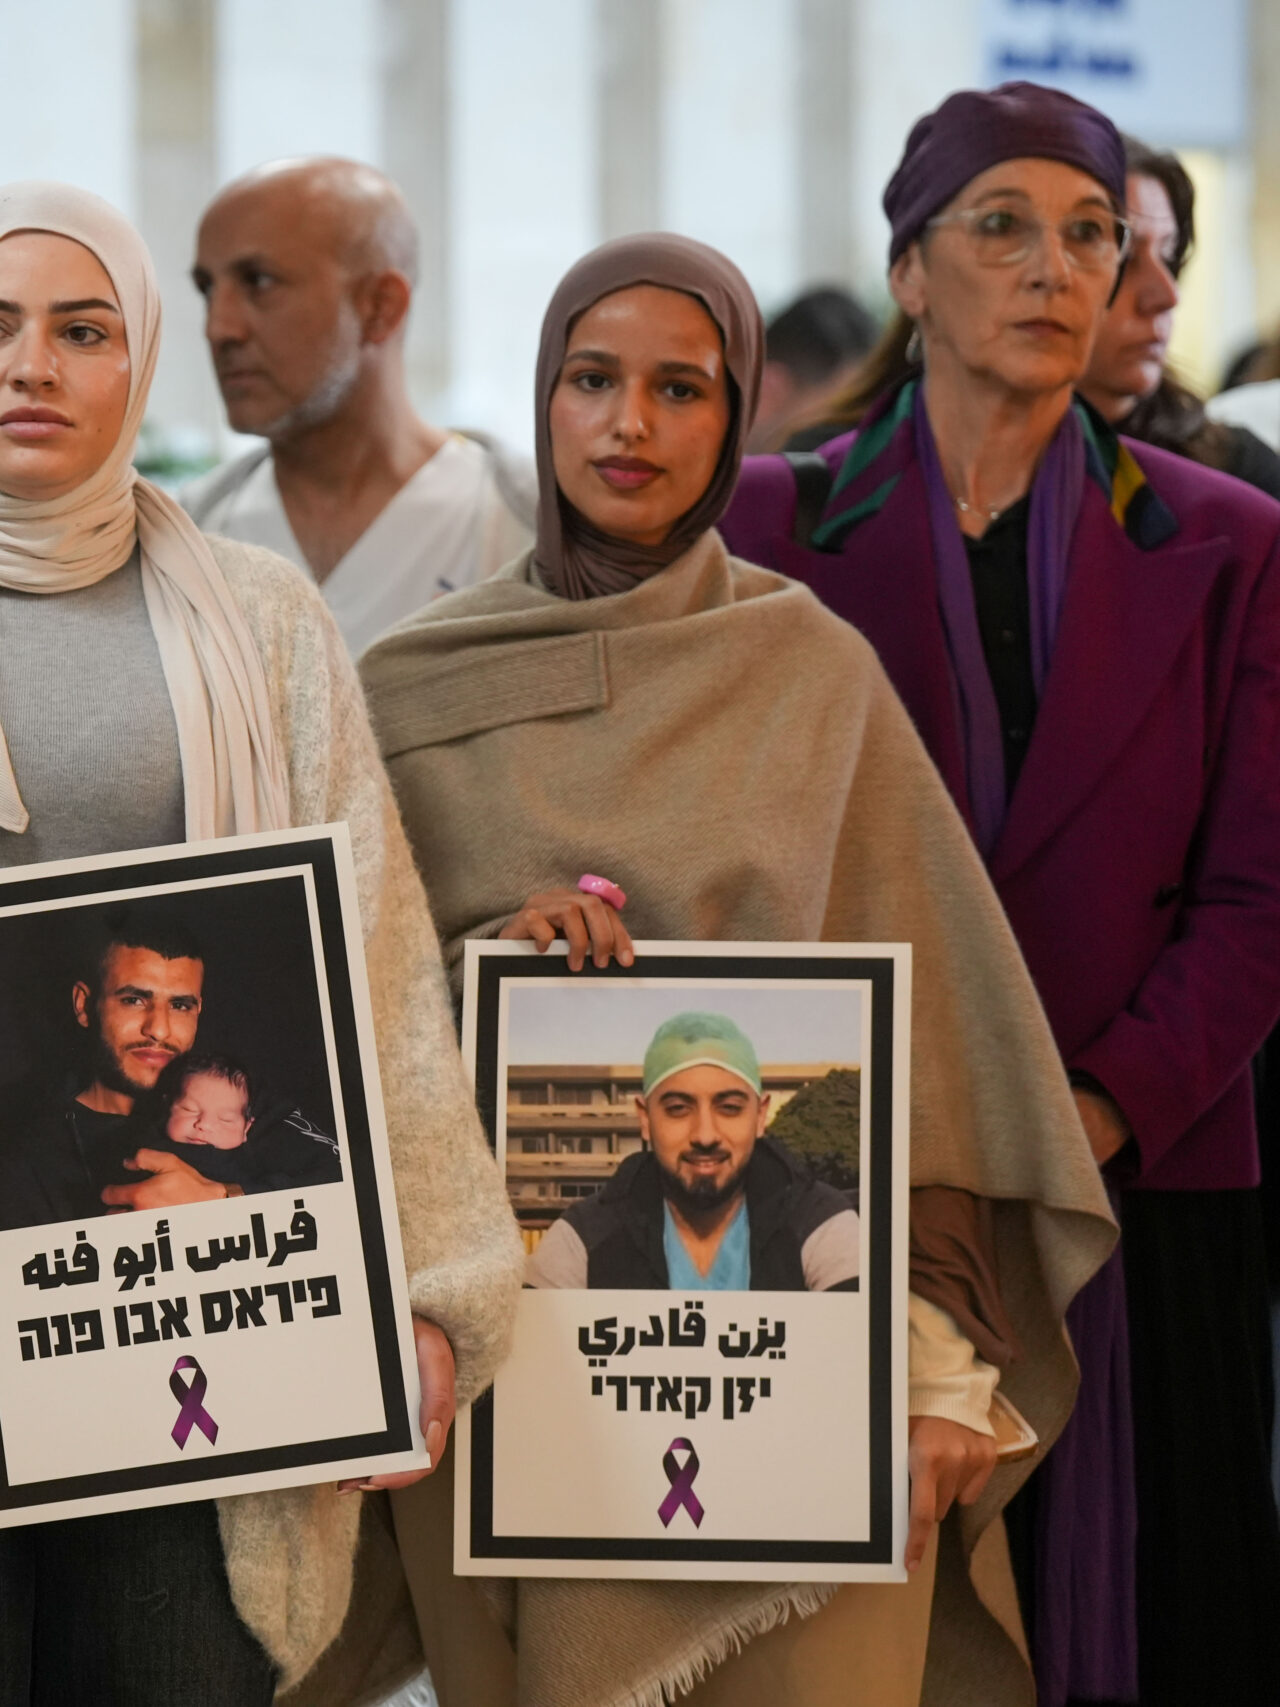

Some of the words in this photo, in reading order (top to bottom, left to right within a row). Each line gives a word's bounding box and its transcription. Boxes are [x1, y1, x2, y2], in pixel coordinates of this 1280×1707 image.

[22, 1230, 100, 1290] فنه
[113, 1219, 174, 1292] أبو
[185, 1198, 318, 1273] فراس
[113, 1296, 192, 1347] אבו
[199, 1274, 342, 1335] פיראס
[17, 1309, 106, 1362] פנה
[577, 1300, 707, 1368] قادري
[718, 1316, 787, 1360] يزن
[591, 1375, 712, 1420] קאדרי
[722, 1376, 771, 1420] יזן
